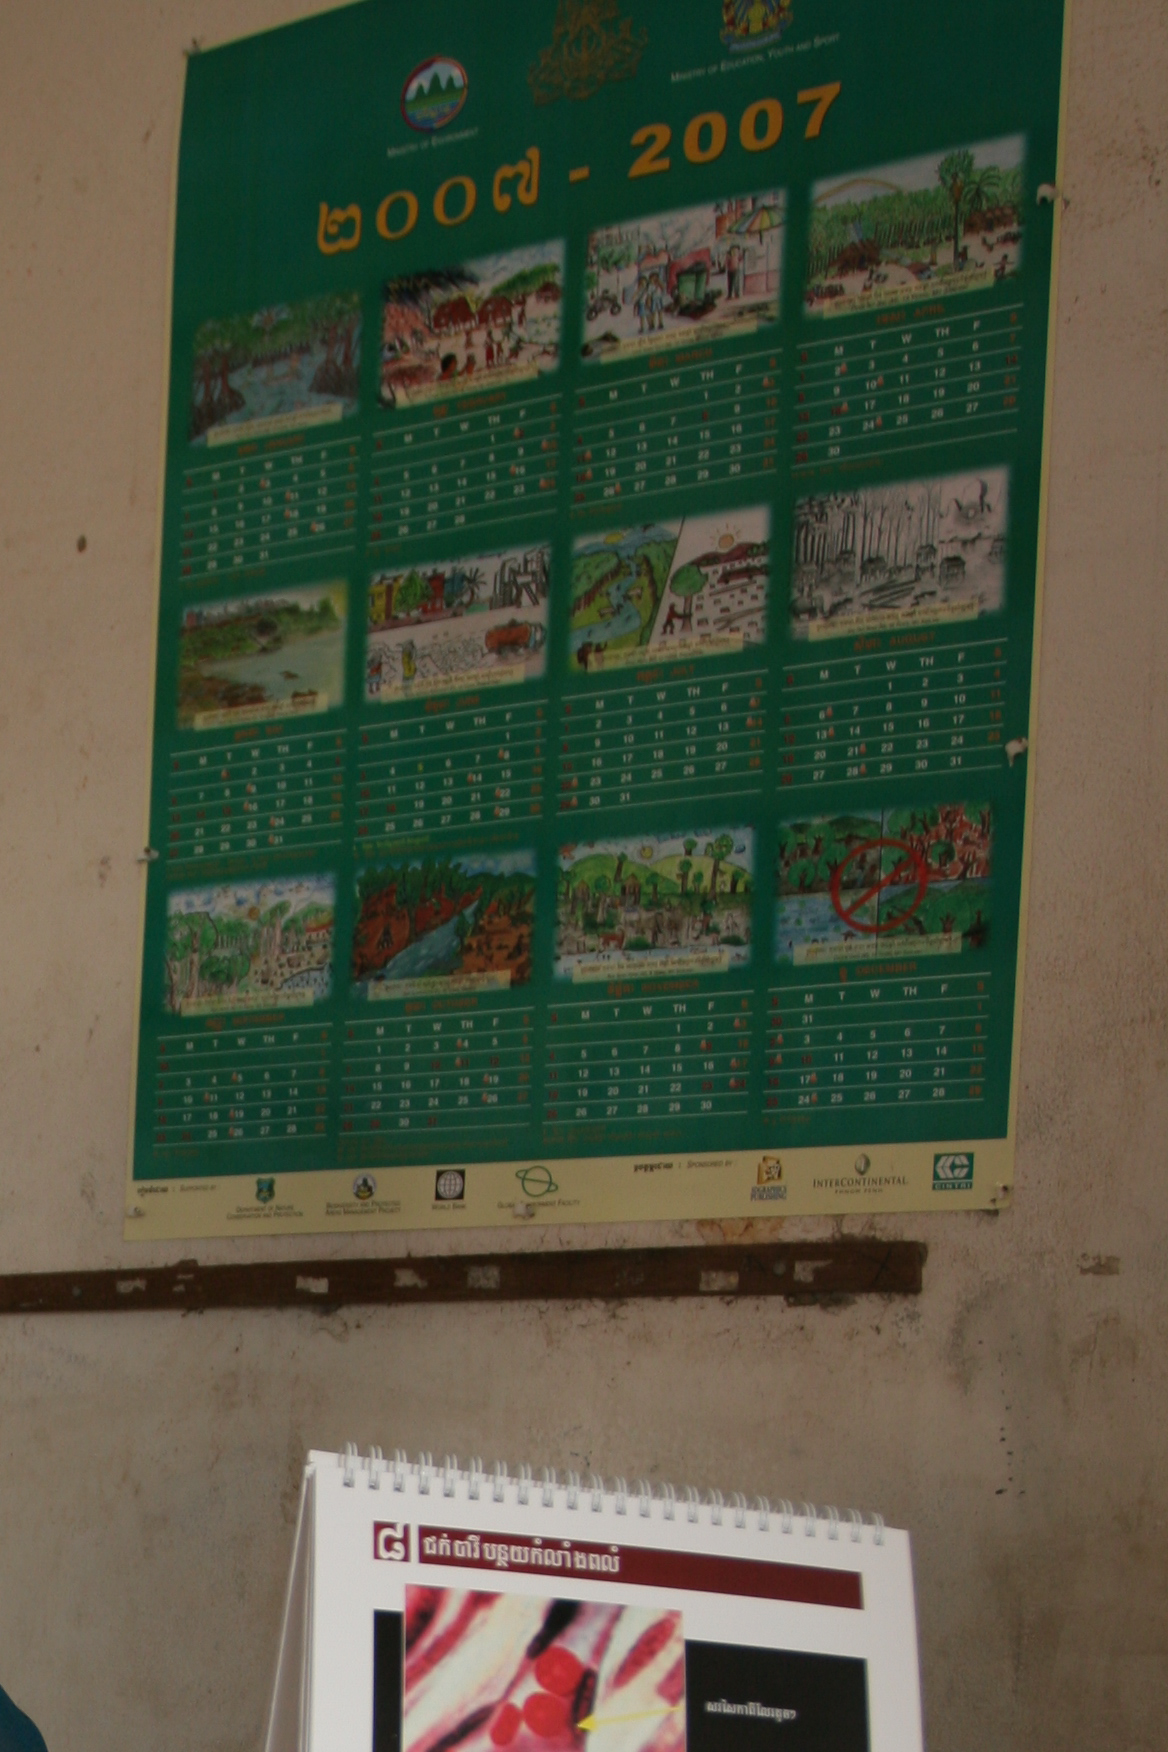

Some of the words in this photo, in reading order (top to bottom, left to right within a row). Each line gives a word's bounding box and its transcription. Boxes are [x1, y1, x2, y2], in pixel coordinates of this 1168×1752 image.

[627, 81, 841, 179] 2007
[870, 339, 877, 350] T
[901, 332, 913, 345] W
[935, 326, 949, 338] TH
[972, 319, 981, 331] F
[854, 663, 862, 675] T
[885, 659, 897, 671] W
[919, 655, 934, 667] TH
[957, 651, 965, 663] F
[838, 990, 846, 1001] T
[869, 988, 881, 999] W
[902, 985, 917, 996] TH
[940, 983, 949, 994] F
[613, 1007, 620, 1018] T
[642, 1005, 653, 1016] W
[672, 1003, 686, 1013] TH
[707, 1000, 715, 1011] F
